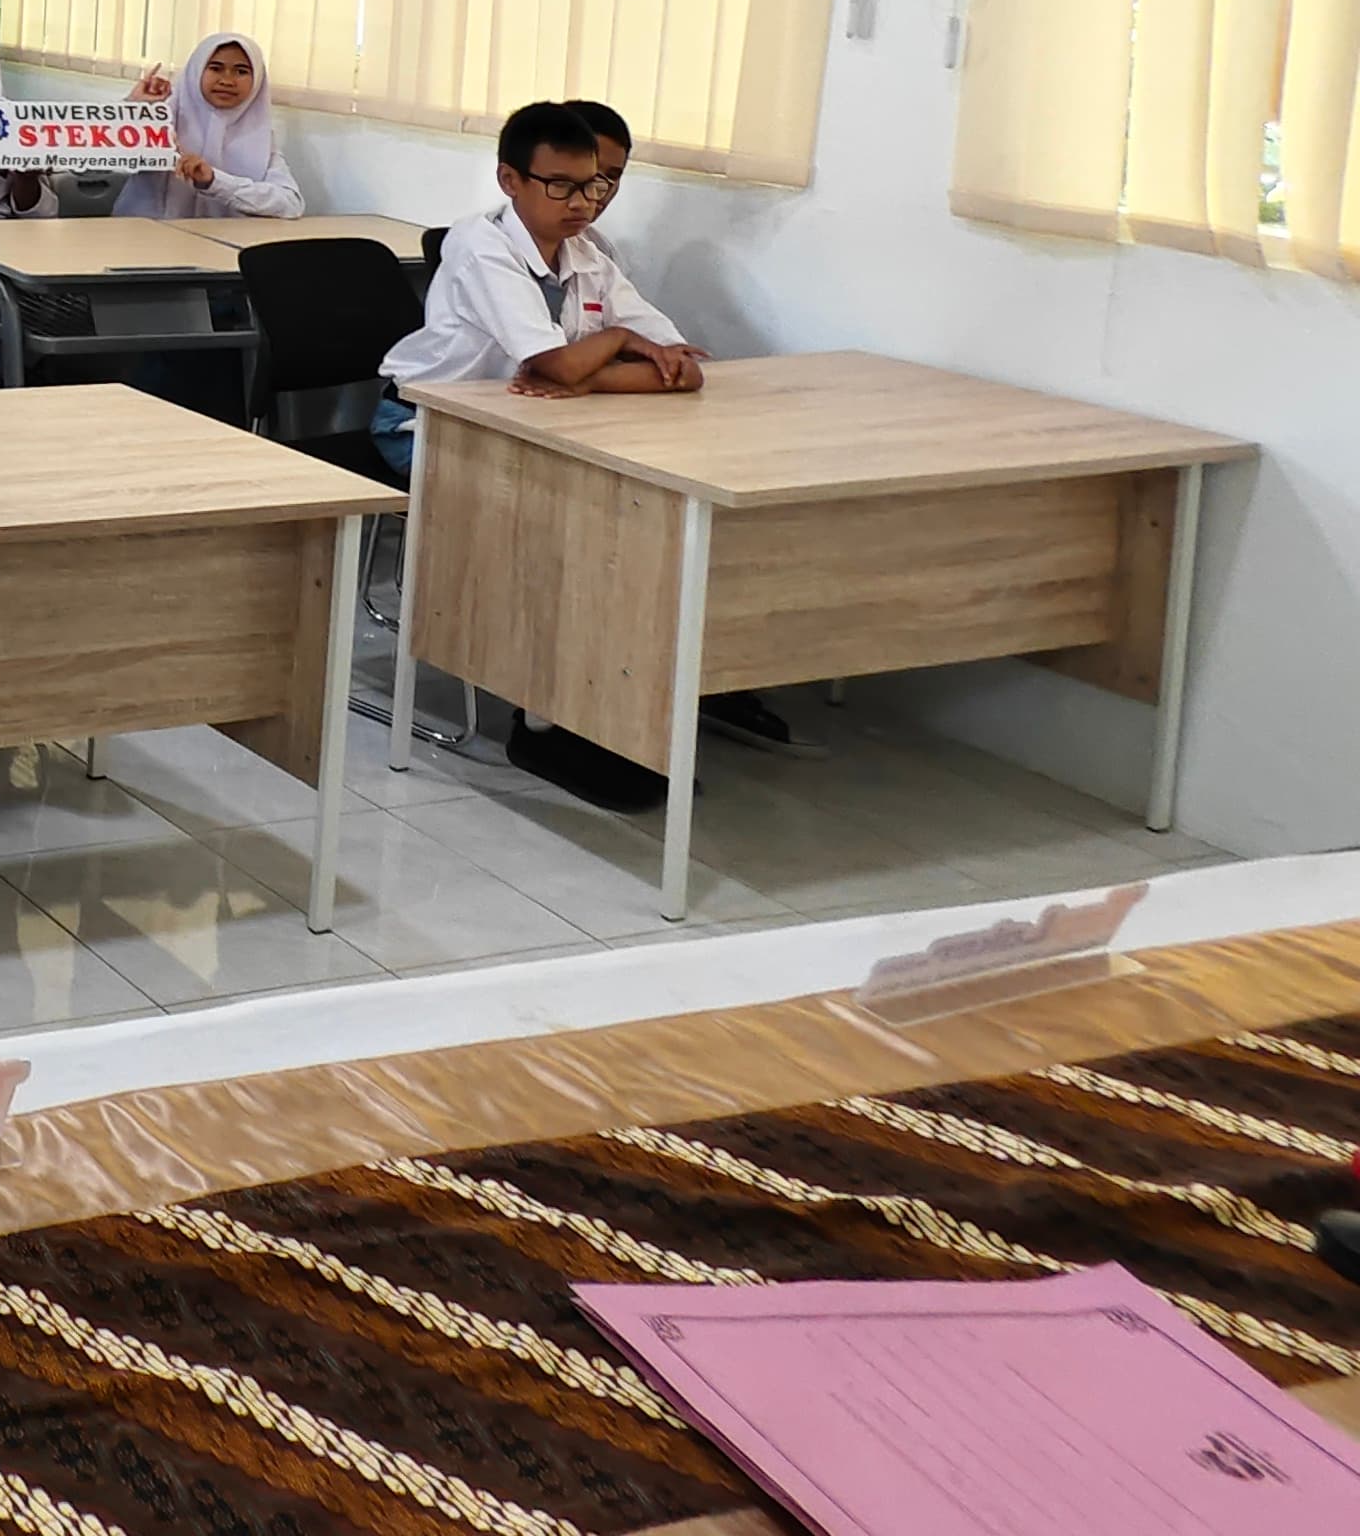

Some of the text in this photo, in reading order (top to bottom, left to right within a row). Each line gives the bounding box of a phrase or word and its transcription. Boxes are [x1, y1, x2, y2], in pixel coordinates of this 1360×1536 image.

[14, 105, 169, 121] UNIVERSITAS
[18, 124, 172, 148] STEKOM
[45, 154, 168, 170] Menyenangkan
